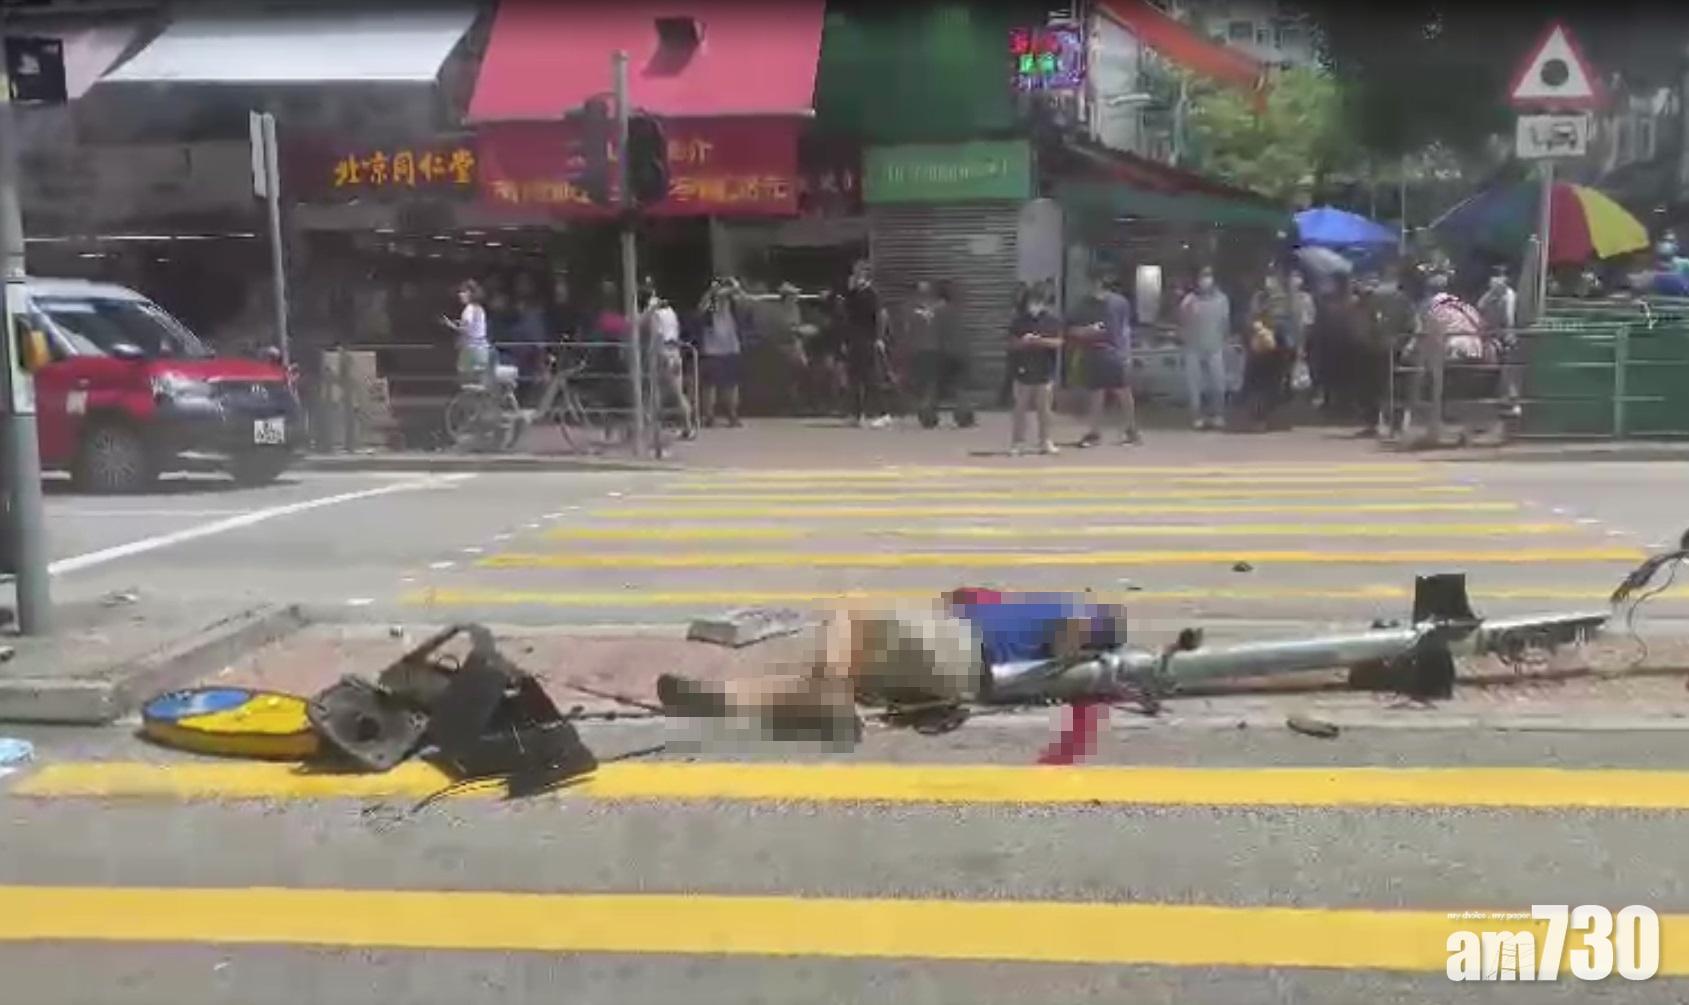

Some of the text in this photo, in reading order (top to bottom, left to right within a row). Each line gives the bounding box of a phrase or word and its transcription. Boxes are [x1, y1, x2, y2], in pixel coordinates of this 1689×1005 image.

[333, 148, 475, 188] 北京同仁堂
